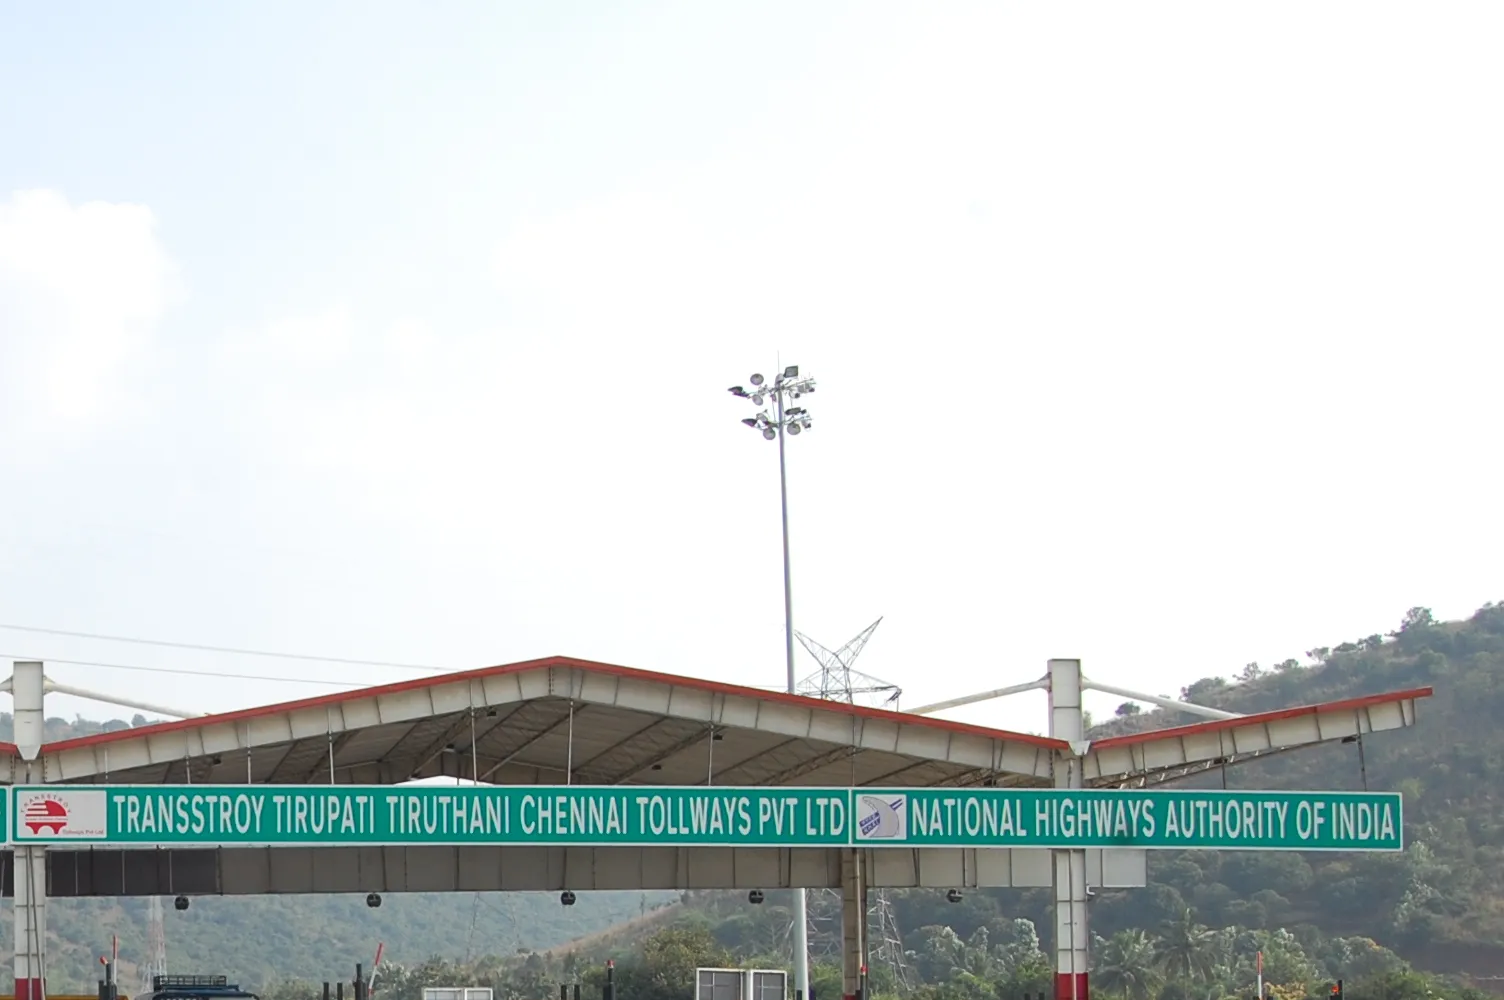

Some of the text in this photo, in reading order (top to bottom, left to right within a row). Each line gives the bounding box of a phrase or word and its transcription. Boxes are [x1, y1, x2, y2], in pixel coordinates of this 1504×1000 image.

[113, 794, 264, 833] TRANSSTROY
[273, 796, 374, 833] TIRUPATI
[386, 796, 509, 834] TIRUTHANI
[521, 795, 627, 834] CHENNAI
[636, 796, 751, 835] TOLLWAYS
[759, 798, 798, 835] PVT
[807, 798, 844, 835] LTD
[913, 797, 1027, 836] NATIONAL
[1036, 798, 1155, 837] HIGHWAYS
[1165, 800, 1288, 838] AUTHORITY
[1297, 801, 1325, 839] OF
[1332, 803, 1395, 840] INDIA
